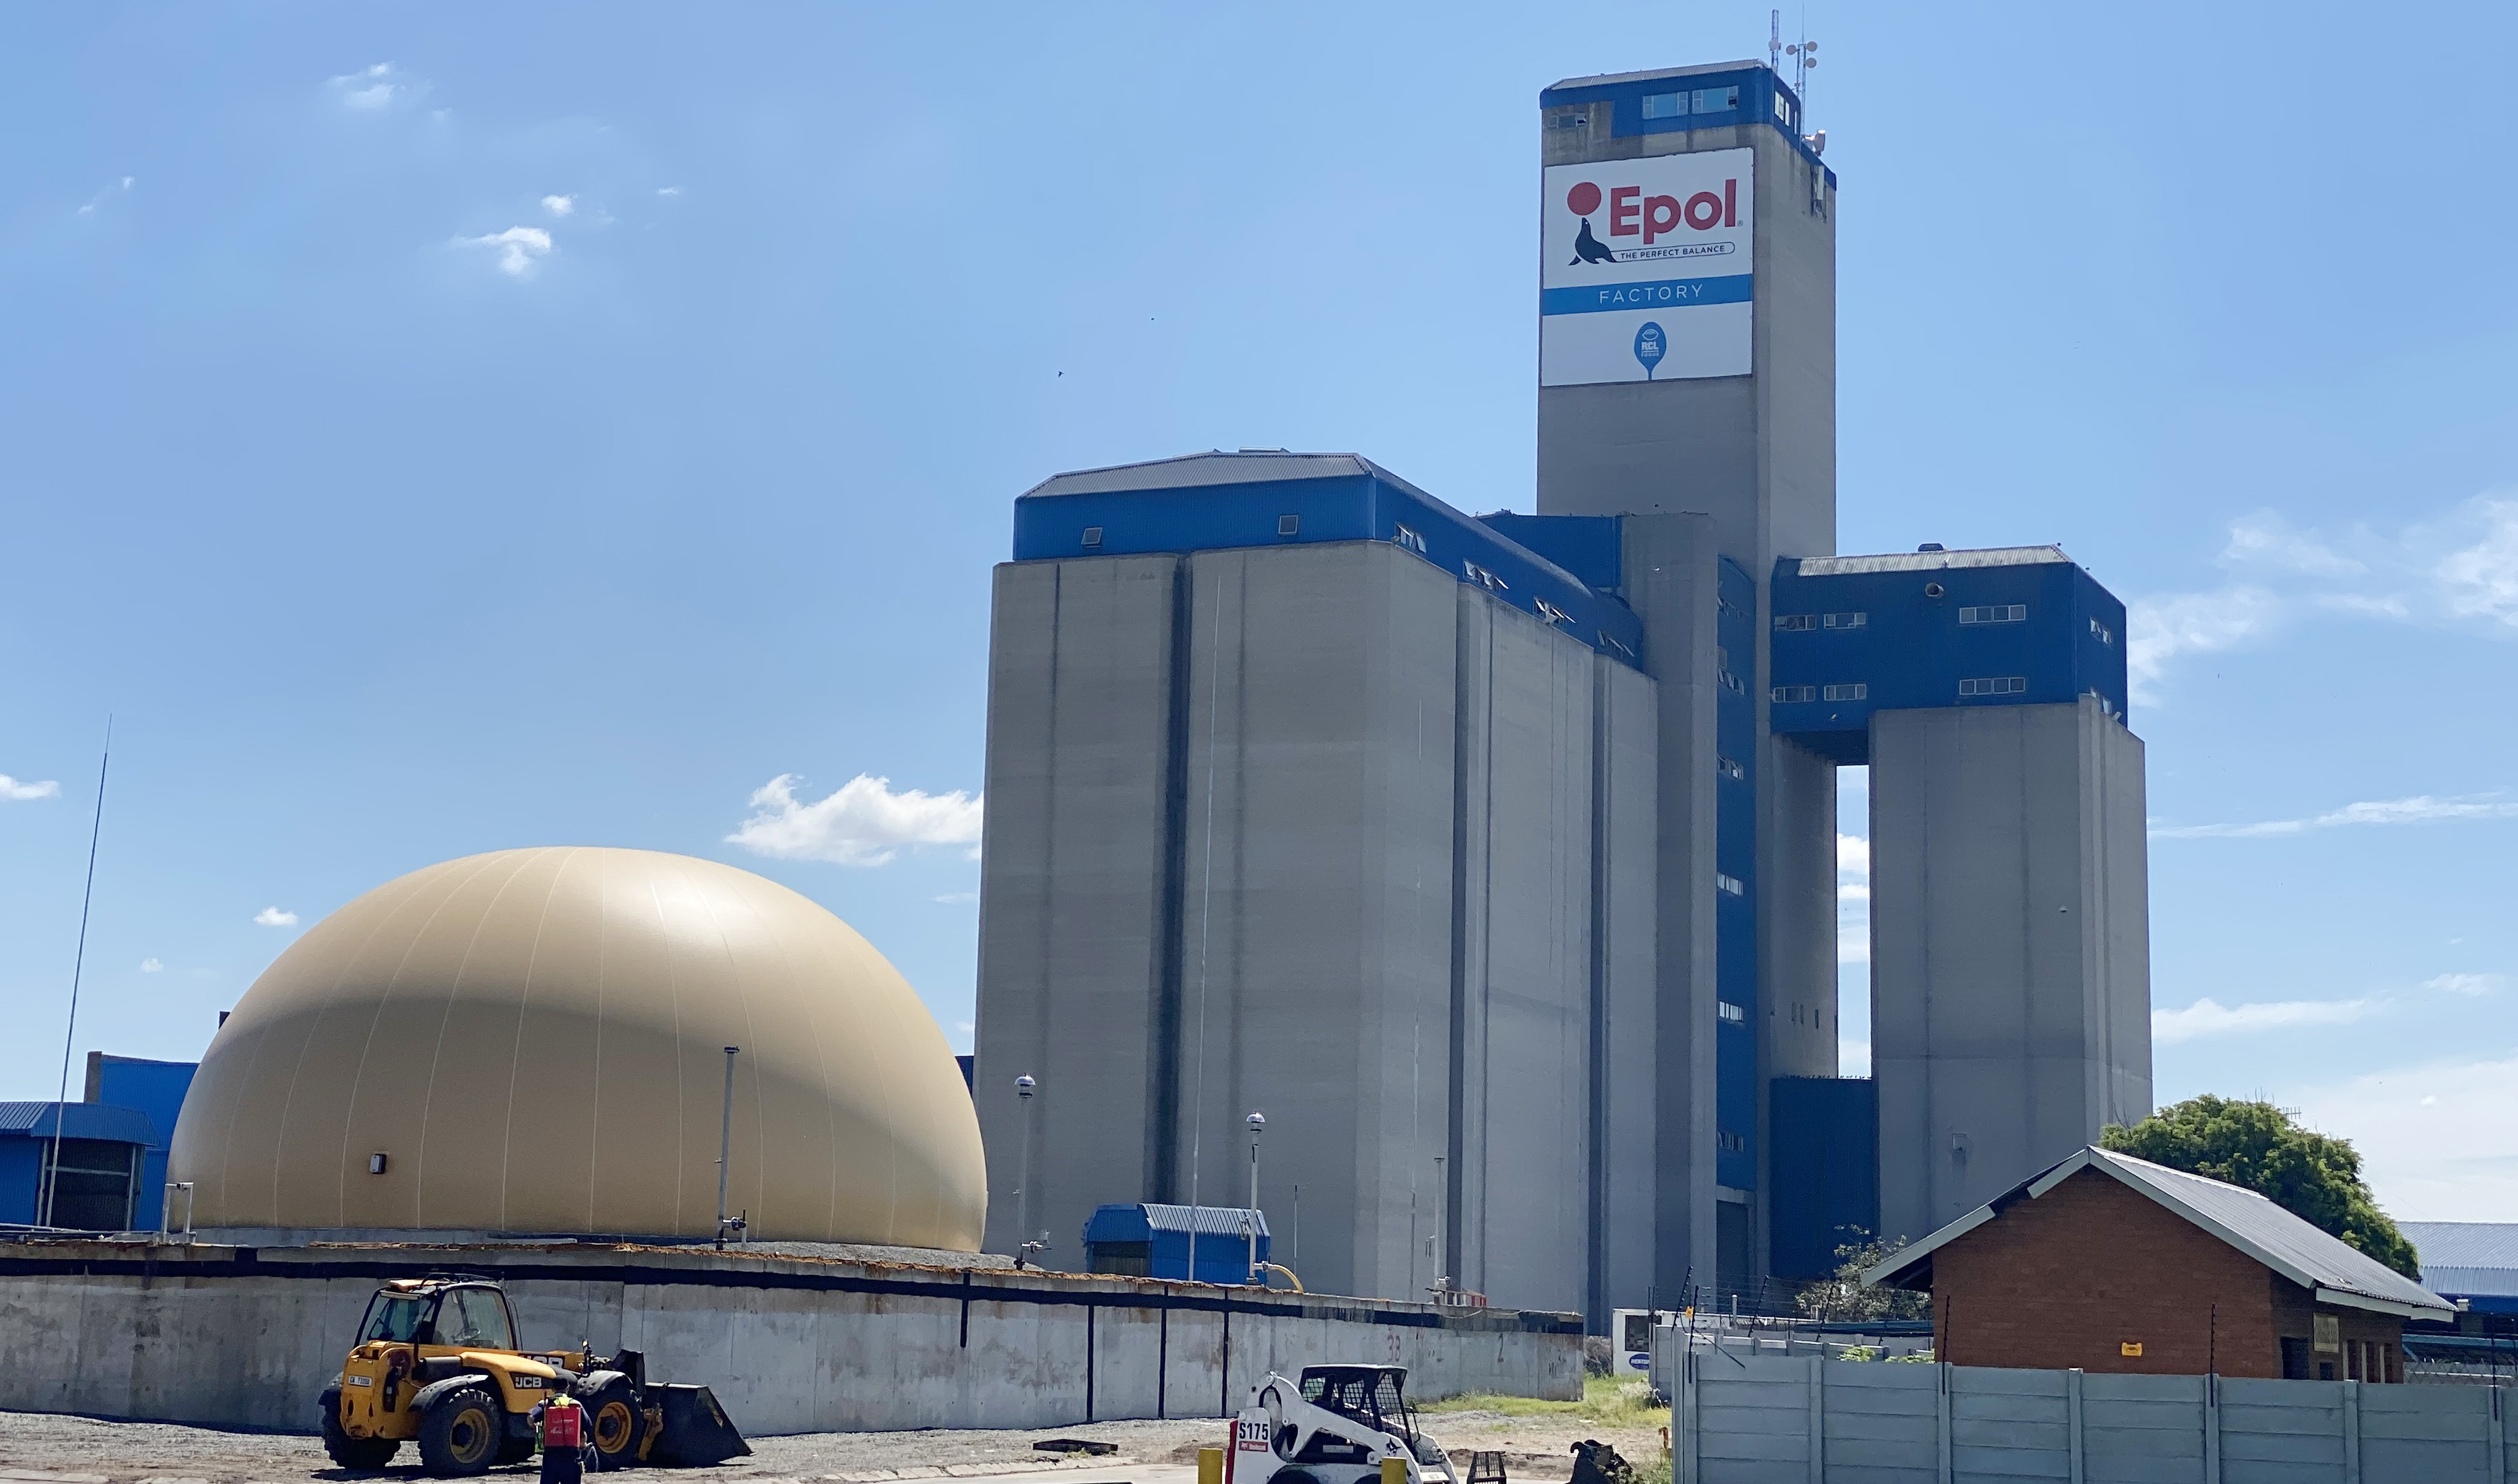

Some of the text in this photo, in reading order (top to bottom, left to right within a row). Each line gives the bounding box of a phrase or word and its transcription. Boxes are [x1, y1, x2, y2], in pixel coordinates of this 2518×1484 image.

[1611, 179, 1737, 245] Epol
[1620, 245, 1725, 260] THE PERFECT BALANCE
[1600, 284, 1703, 304] FACTORY
[515, 1377, 542, 1388] JCB
[1239, 1422, 1268, 1440] S175
